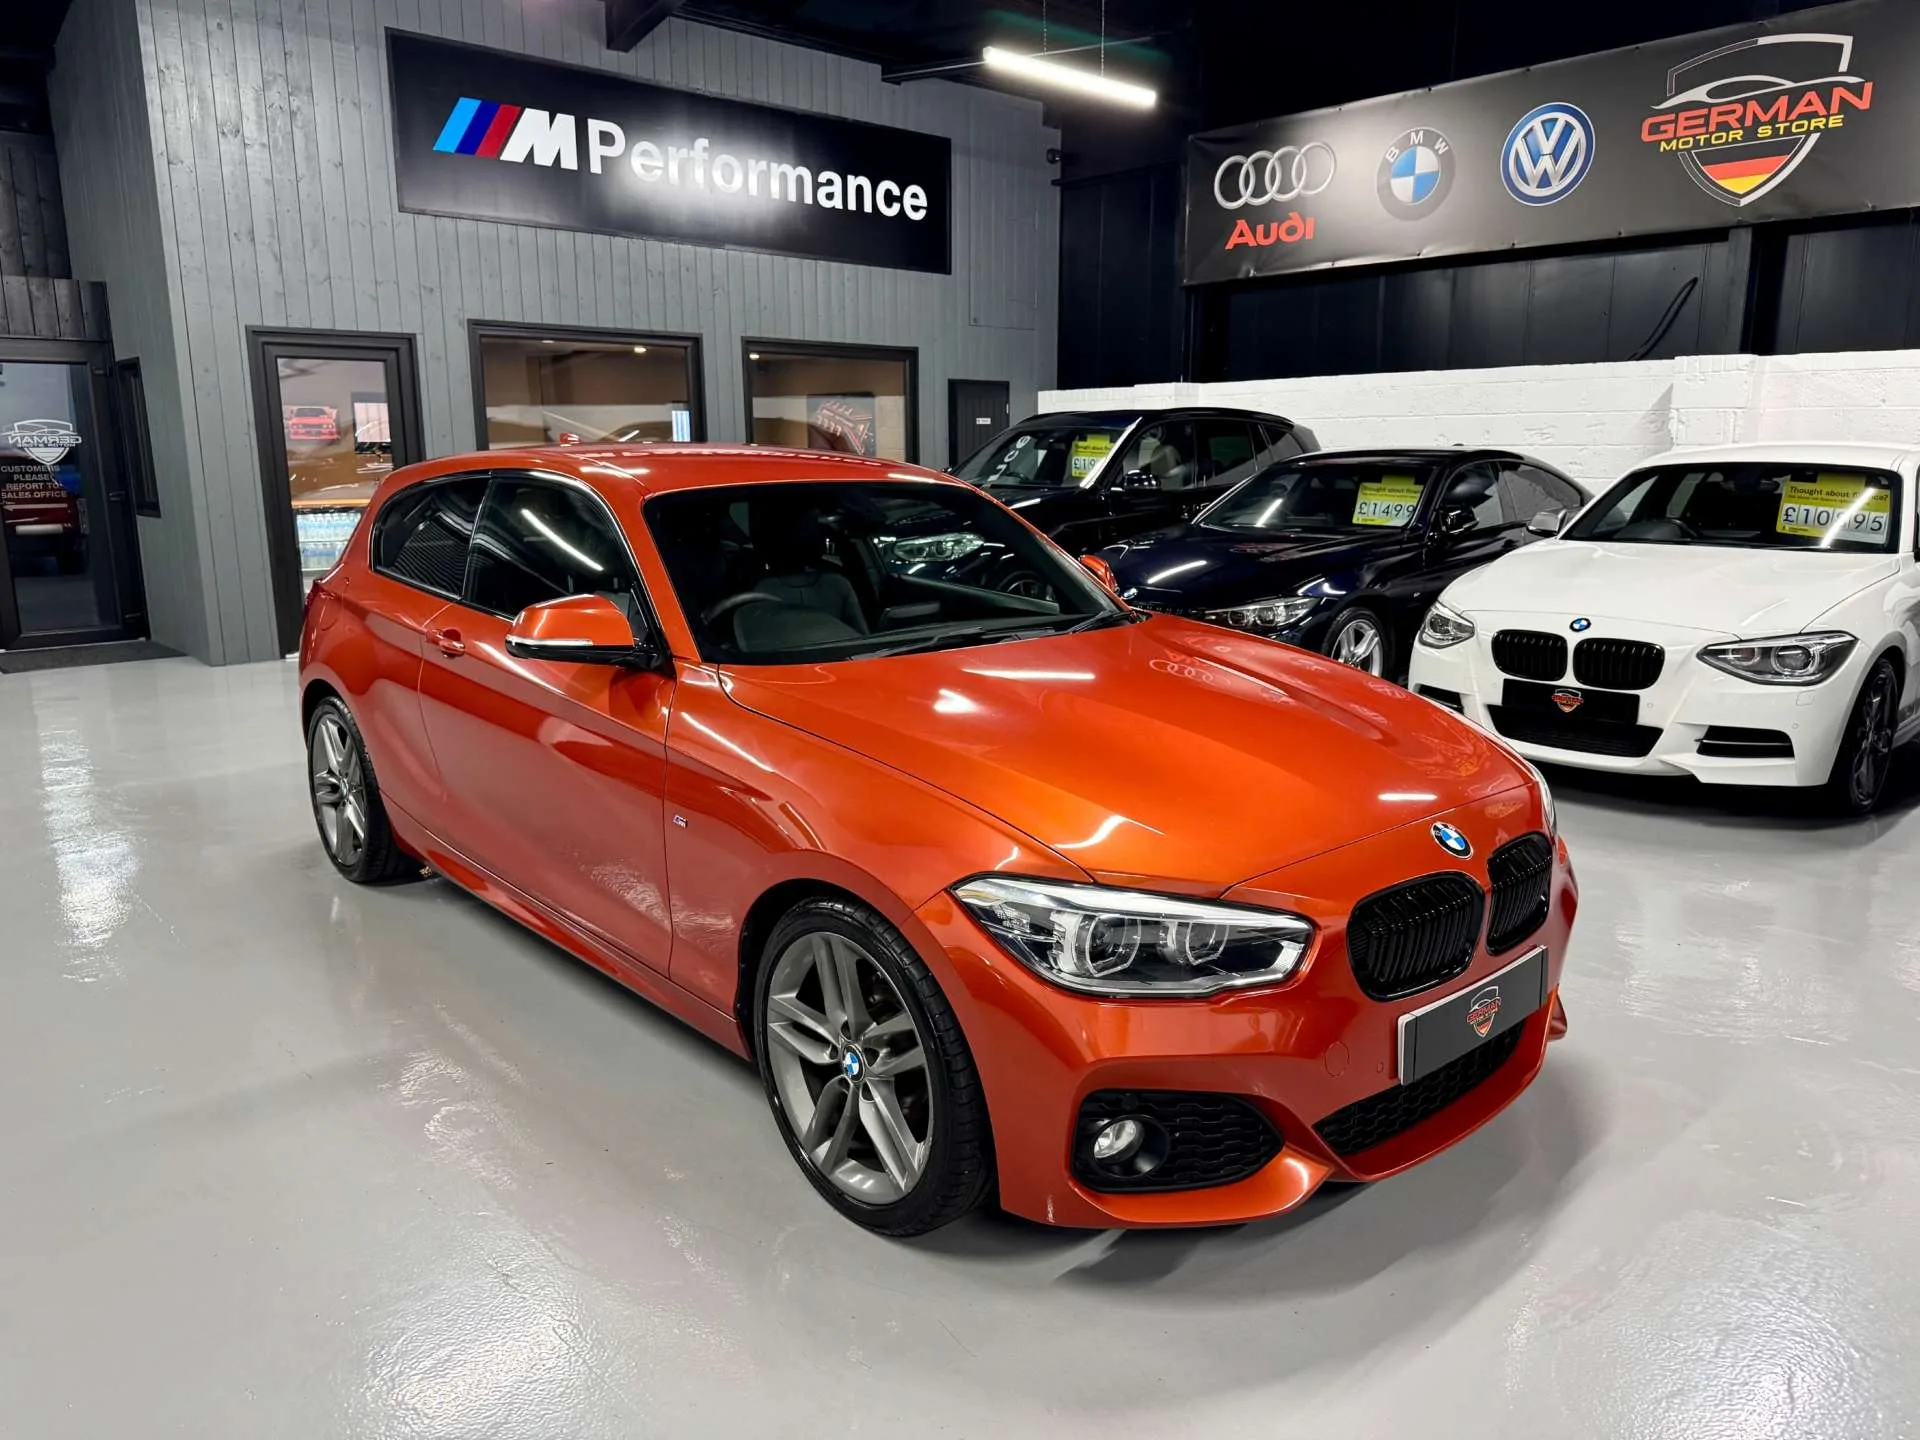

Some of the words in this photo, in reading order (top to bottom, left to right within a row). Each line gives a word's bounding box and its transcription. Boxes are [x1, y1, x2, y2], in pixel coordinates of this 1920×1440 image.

[1641, 82, 1873, 142] GERMAN
[1385, 130, 1449, 163] BMW
[1659, 129, 1743, 153] MOTOR
[1757, 114, 1844, 138] STORE
[500, 107, 578, 171] M
[587, 118, 928, 221] Performance
[1225, 211, 1315, 250] Audi
[13, 473, 51, 481] PLEASE
[33, 490, 67, 498] OFFICE
[1790, 486, 1822, 496] Thought
